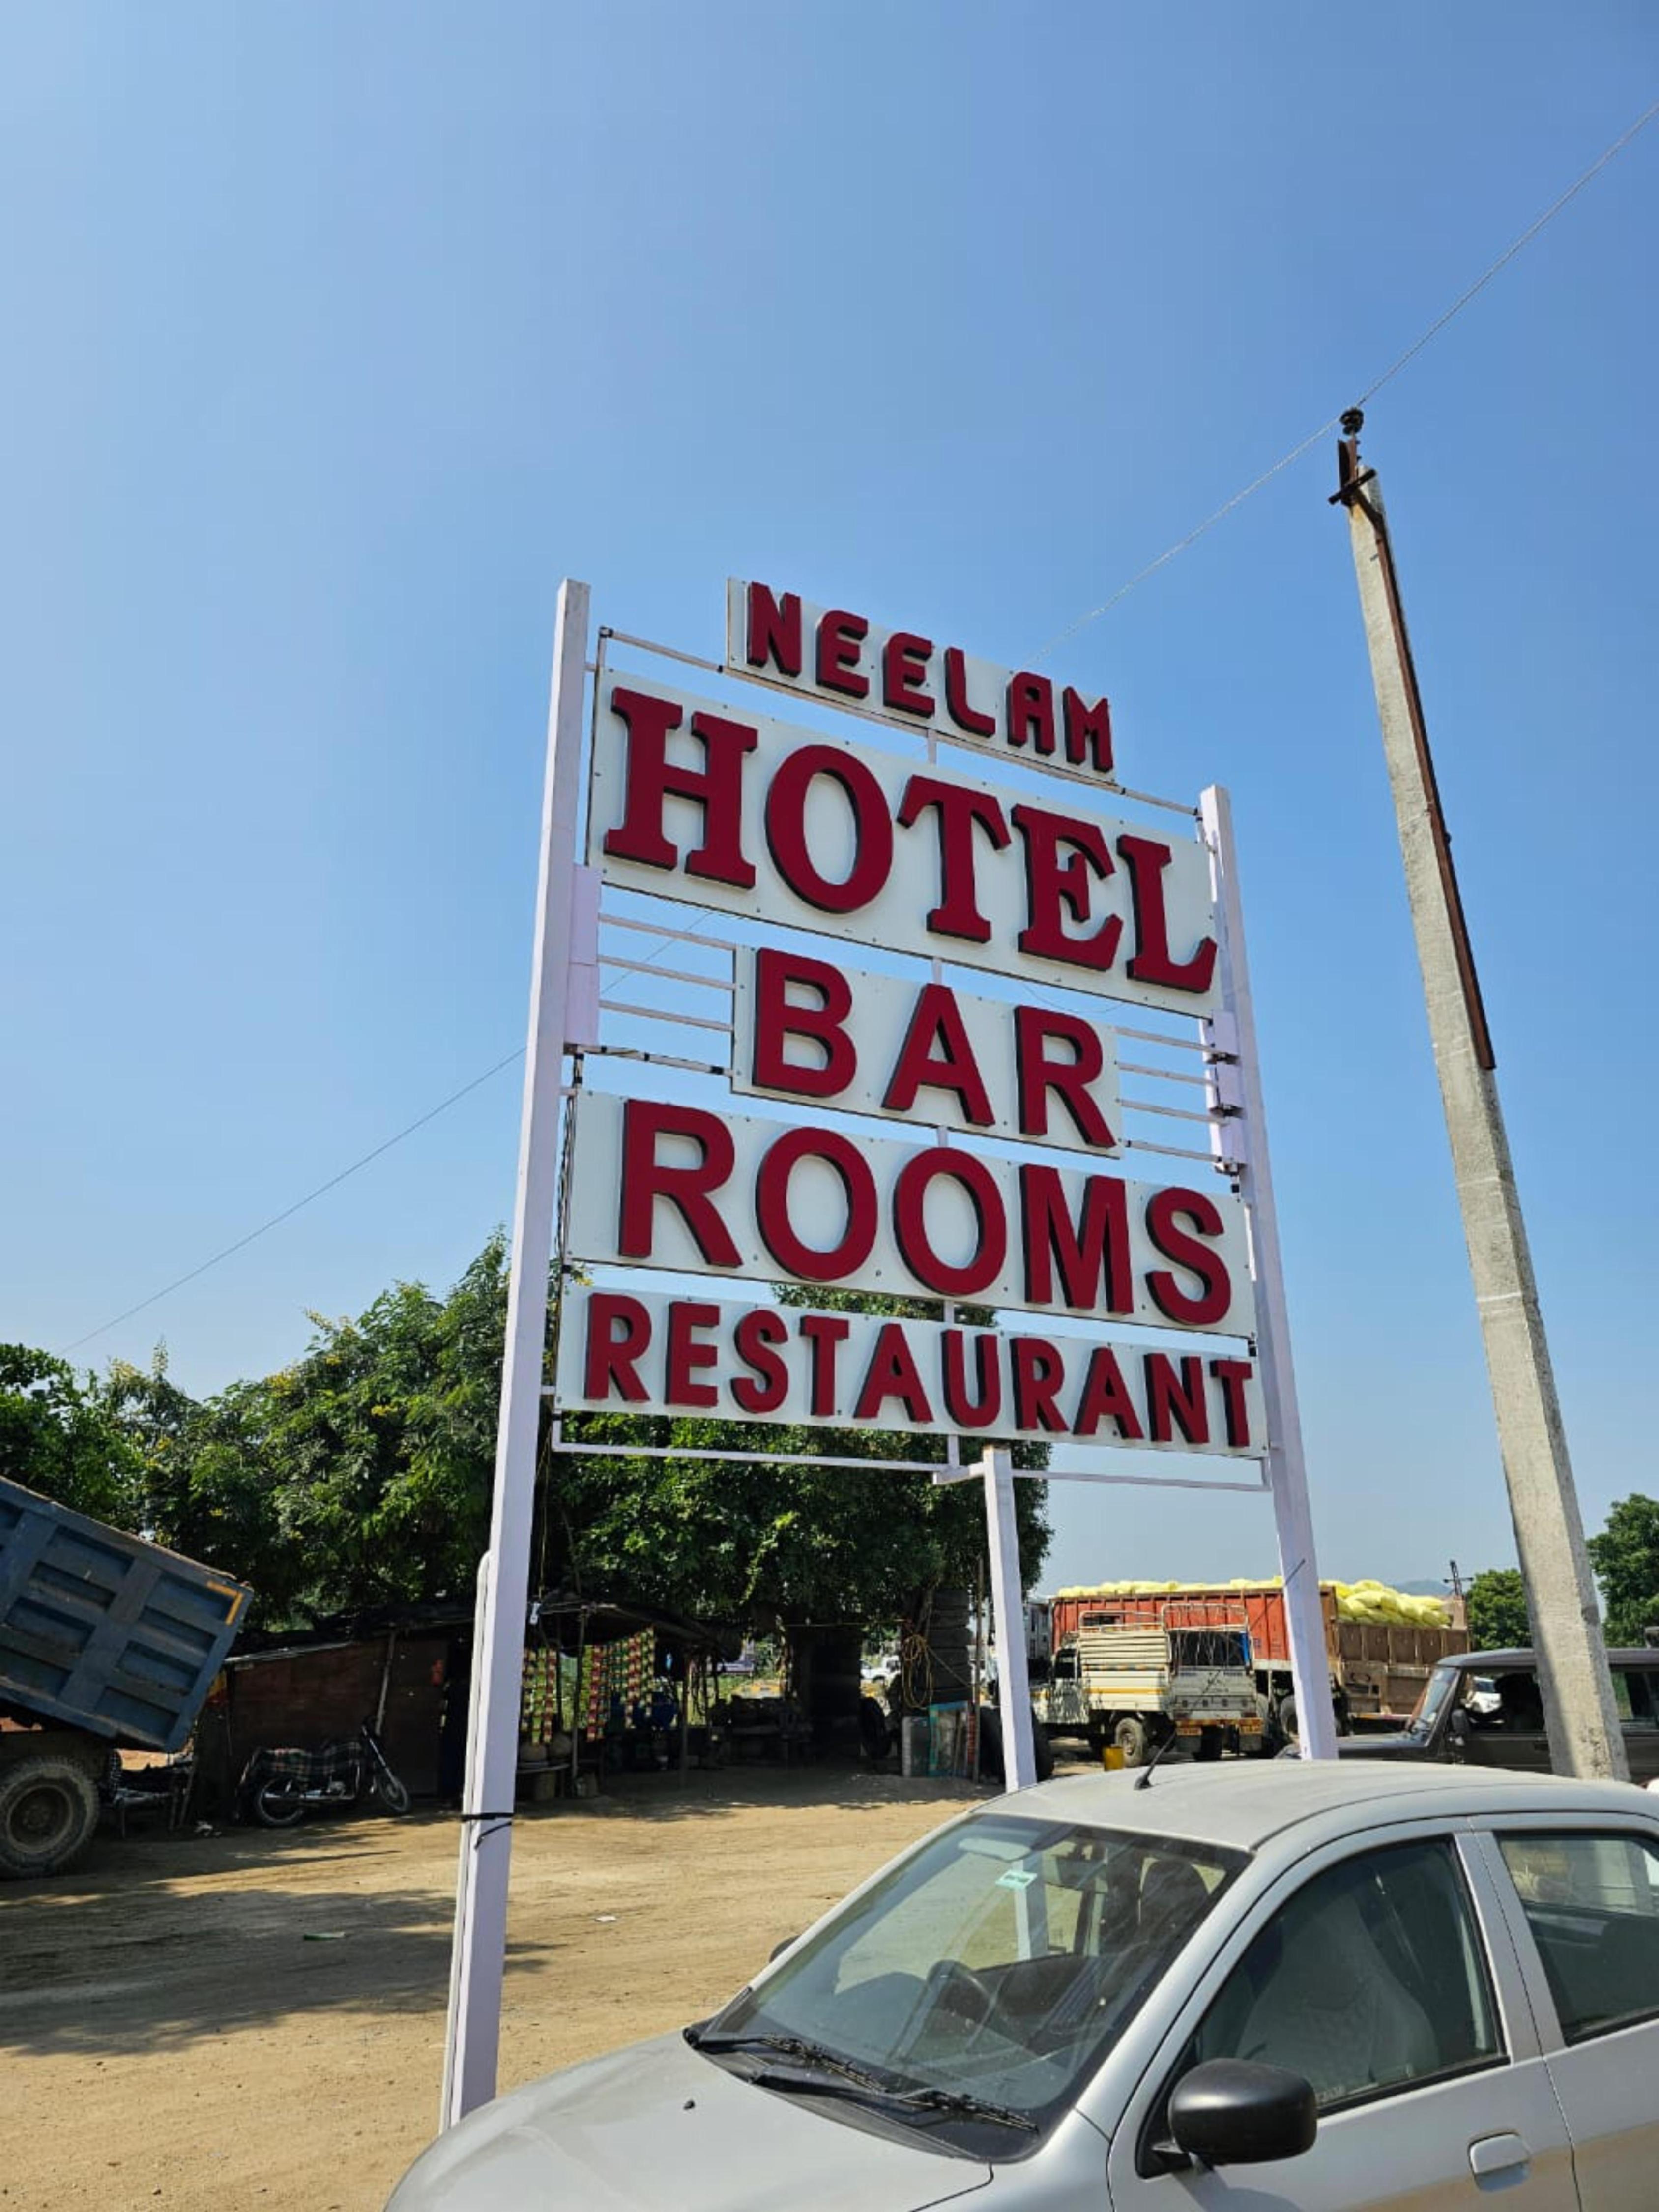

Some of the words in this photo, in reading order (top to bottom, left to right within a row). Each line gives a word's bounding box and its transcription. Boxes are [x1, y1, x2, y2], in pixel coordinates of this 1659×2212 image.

[745, 581, 1116, 774] NEELAM
[603, 686, 1218, 994] HOTEL
[752, 948, 1116, 1150] BAR
[617, 1100, 1232, 1327] ROOMS
[584, 1293, 1253, 1448] RESTAURANT
